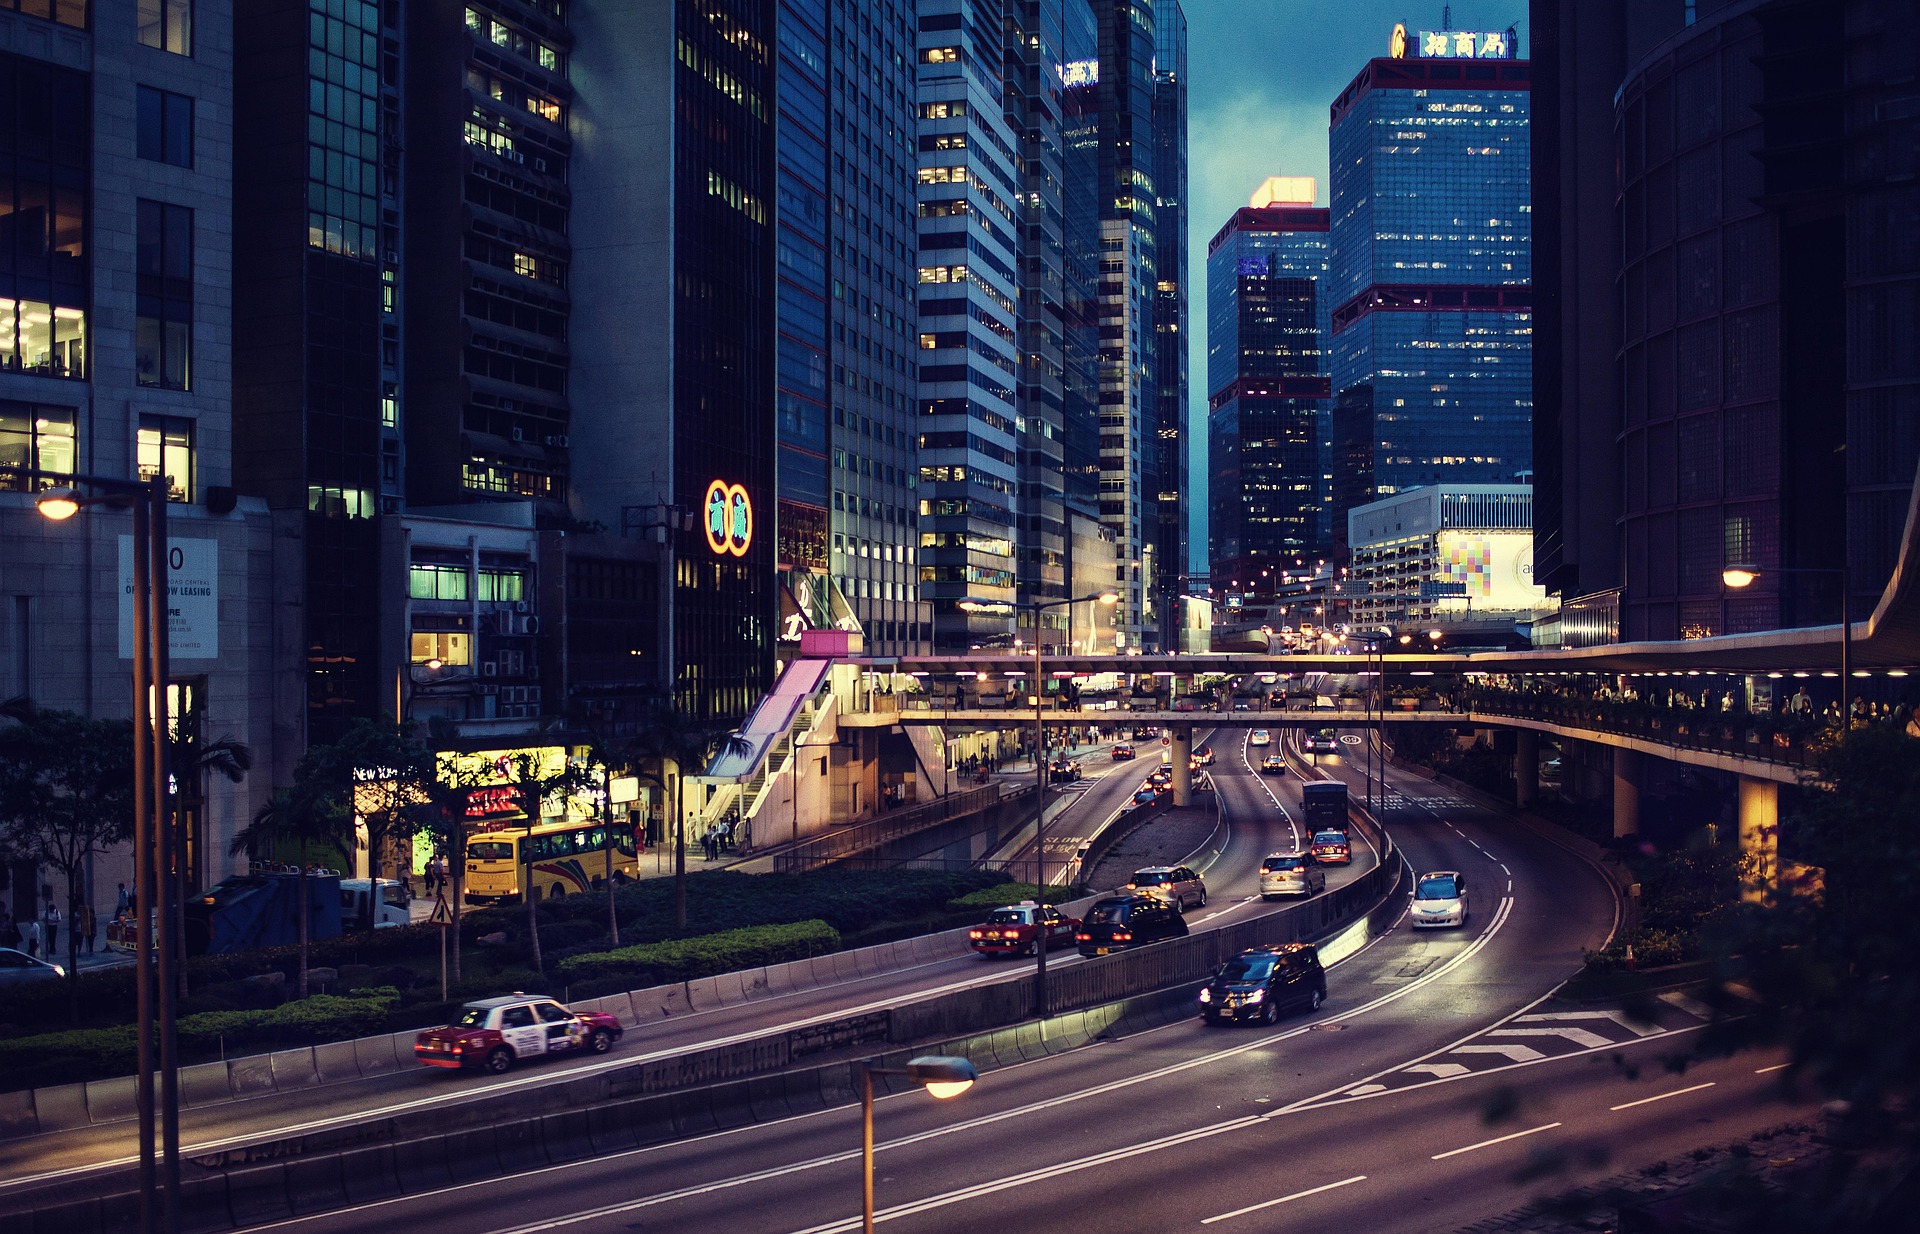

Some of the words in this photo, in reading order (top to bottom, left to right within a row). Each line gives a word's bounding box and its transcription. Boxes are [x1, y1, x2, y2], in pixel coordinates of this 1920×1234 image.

[1425, 32, 1504, 56] 招商局
[180, 587, 211, 597] LEASING
[352, 767, 376, 781] NEW
